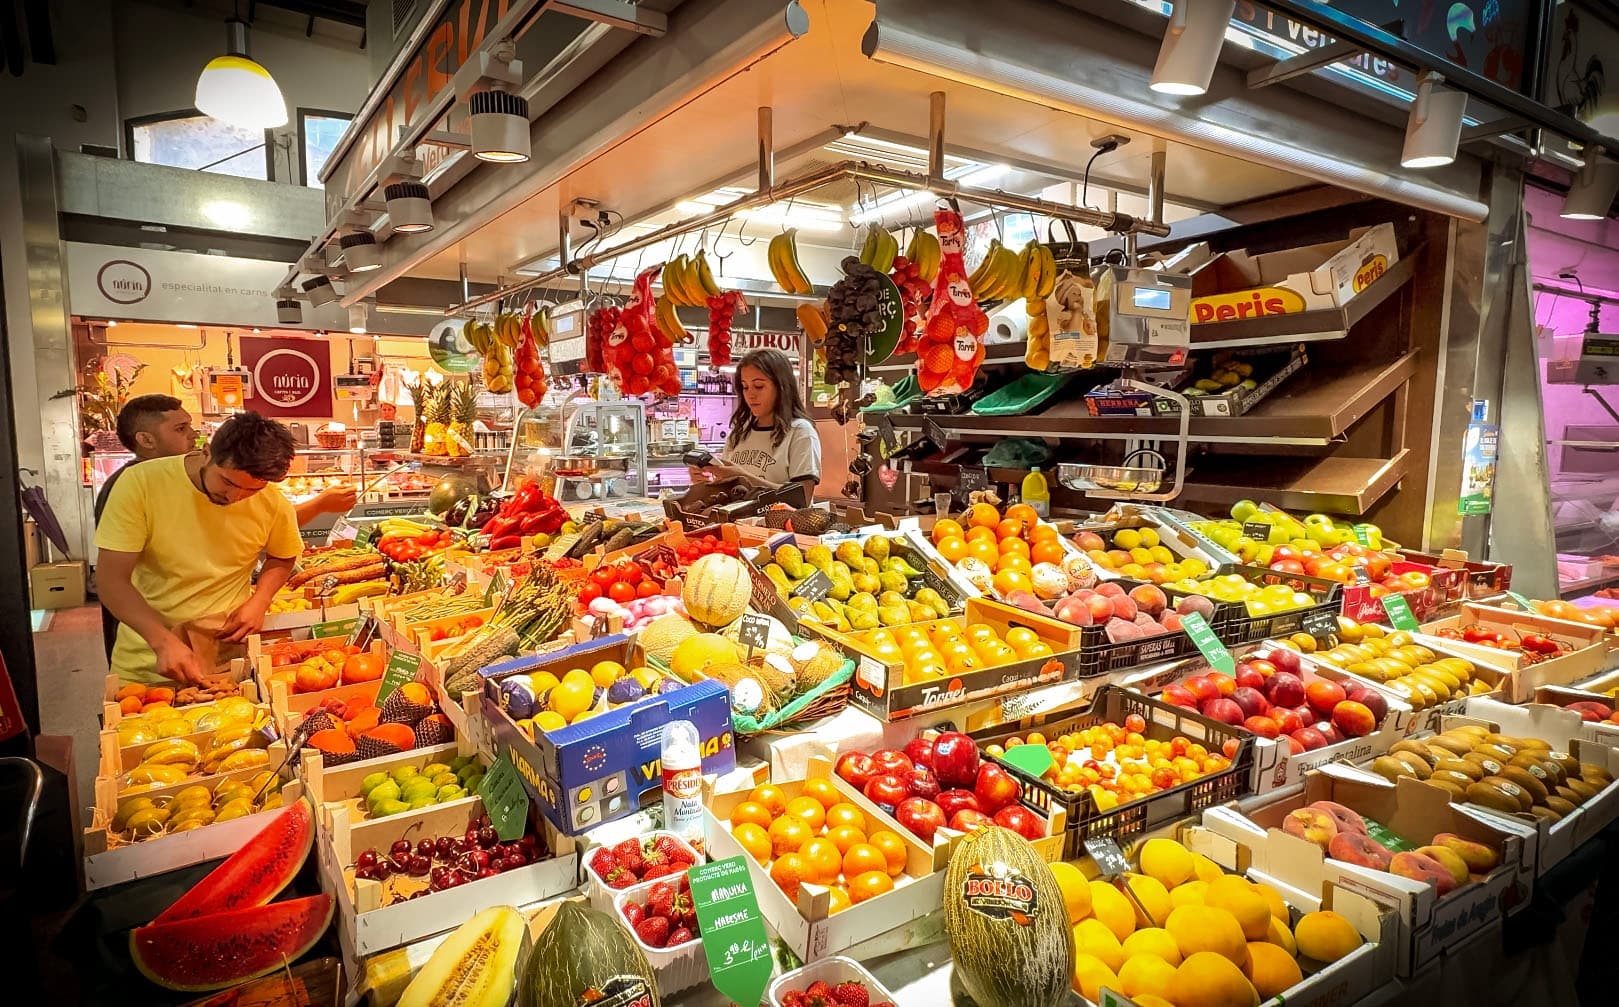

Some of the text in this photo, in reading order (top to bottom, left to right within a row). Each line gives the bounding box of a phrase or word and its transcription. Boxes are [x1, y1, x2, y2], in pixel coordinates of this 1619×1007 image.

[1357, 261, 1384, 290] Peris
[161, 282, 221, 294] especialitat
[224, 286, 237, 295] en
[239, 287, 268, 297] carns
[1194, 292, 1286, 323] Peris
[273, 373, 309, 388] núria
[921, 686, 967, 706] Torres
[967, 879, 1033, 902] BOLLO
